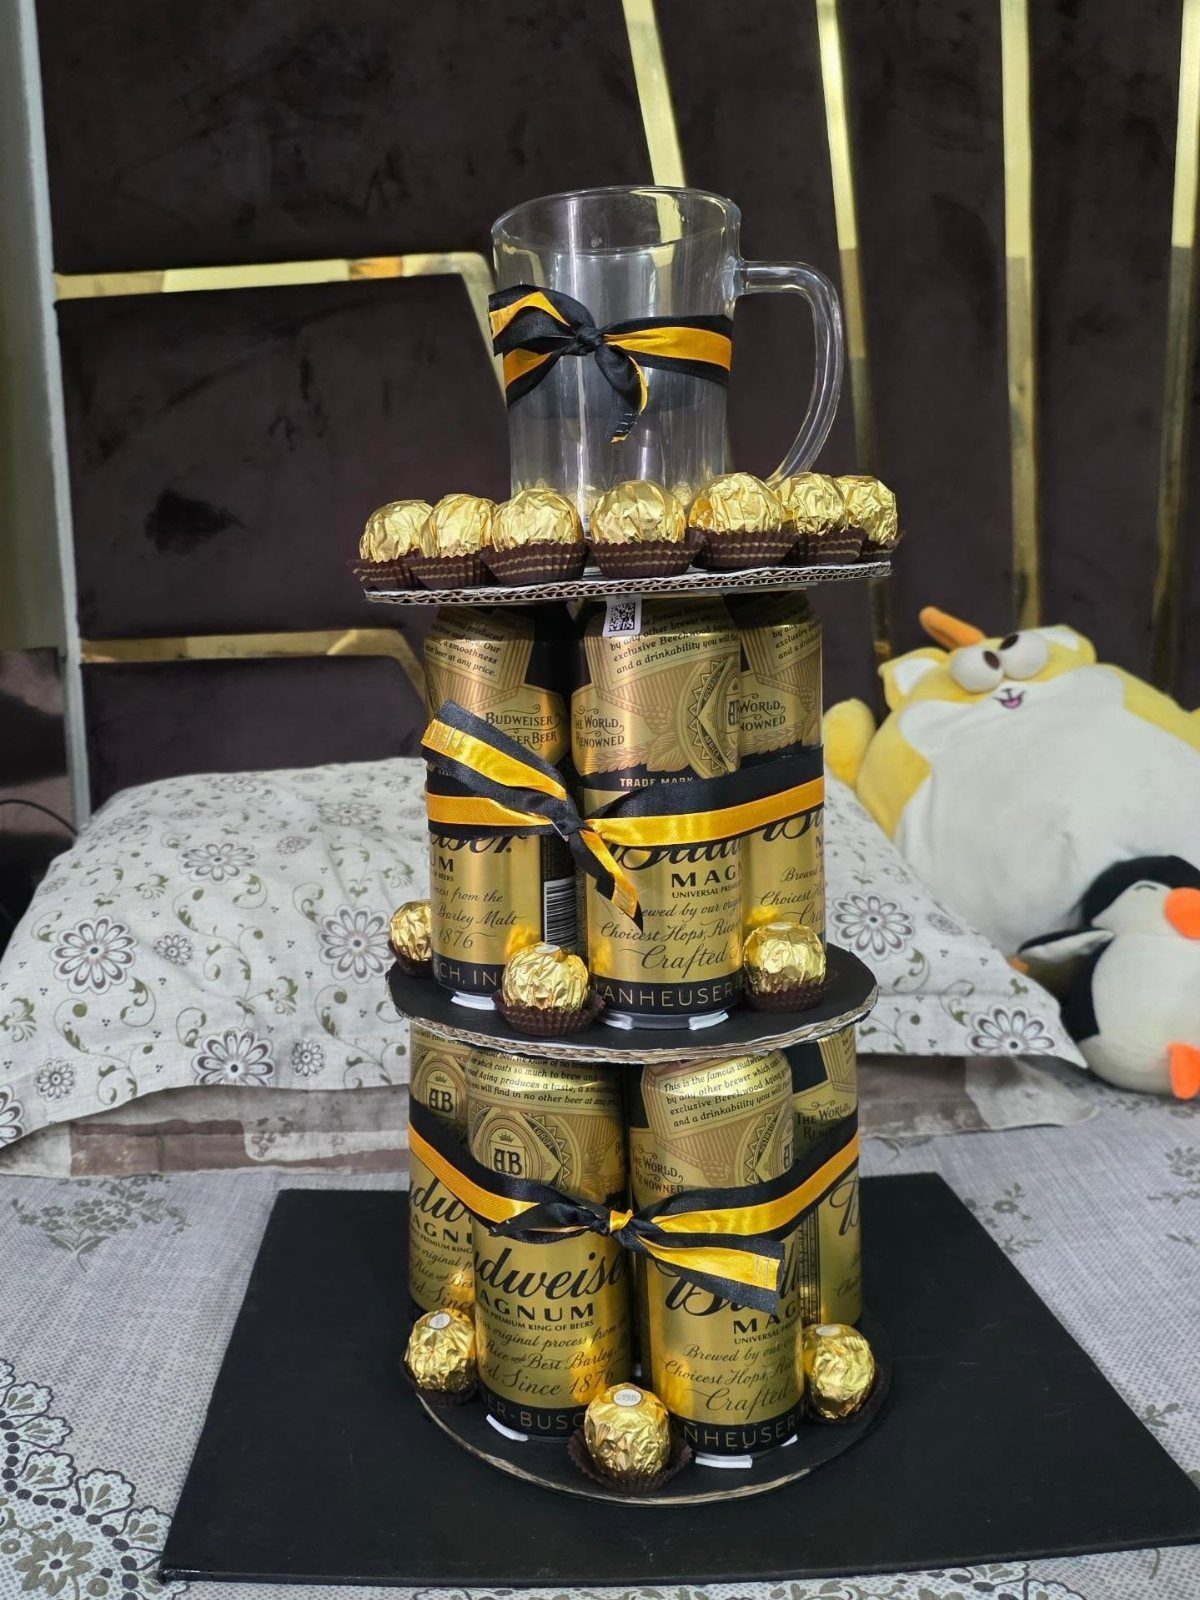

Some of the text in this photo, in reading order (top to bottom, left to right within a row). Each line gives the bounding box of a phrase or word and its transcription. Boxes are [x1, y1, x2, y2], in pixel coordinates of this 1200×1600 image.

[610, 641, 621, 652] by
[643, 624, 668, 638] other
[613, 640, 657, 662] exclusive
[659, 625, 711, 645] Beechwood
[771, 629, 783, 639] by
[449, 642, 498, 665] smoothness
[483, 642, 501, 654] Our
[616, 662, 634, 675] and
[644, 641, 701, 664] drinkability
[702, 638, 717, 649] you
[778, 646, 793, 660] and
[448, 653, 456, 662] at
[456, 657, 472, 669] any
[473, 663, 496, 677] price.
[485, 711, 553, 727] BUDWEISER
[532, 731, 558, 744] BEER
[576, 735, 625, 749] RENOWNED
[450, 886, 480, 904] from
[483, 889, 504, 903] the
[671, 887, 719, 899] UNIVERSAL
[758, 889, 811, 906] Choicest
[436, 901, 526, 929] Barley Malt
[679, 902, 698, 923] by
[700, 902, 721, 914] our
[439, 927, 494, 949] 1876
[600, 921, 661, 941] Choicest
[660, 923, 706, 945] Hops,
[624, 940, 728, 979] Crafted
[473, 969, 497, 986] IN
[602, 982, 735, 1007] ANHEUSER
[493, 1062, 512, 1073] costs
[525, 1068, 547, 1078] much
[550, 1071, 559, 1079] to
[560, 1072, 581, 1080] brew
[550, 1060, 559, 1069] of
[478, 1071, 498, 1083] Aging
[500, 1077, 541, 1090] produces
[664, 1082, 681, 1092] This
[683, 1079, 690, 1087] is
[692, 1076, 706, 1085] the
[706, 1066, 735, 1082] famous
[665, 1095, 677, 1105] by
[698, 1083, 722, 1096] other
[724, 1072, 751, 1088] brewer
[752, 1064, 771, 1077] which
[480, 1084, 492, 1094] will
[493, 1086, 510, 1097] find
[537, 1094, 563, 1103] other
[564, 1095, 584, 1104] beer
[584, 1097, 593, 1105] at
[670, 1099, 712, 1116] exclusive
[714, 1080, 763, 1104] Beechwood
[673, 1116, 691, 1128] and
[692, 1115, 698, 1123] a
[700, 1098, 754, 1120] drinkability
[756, 1092, 770, 1104] you
[795, 1112, 817, 1126] THE
[421, 1248, 462, 1267] original
[479, 1288, 595, 1322] AGNUM
[489, 1312, 594, 1332] PREMIUM KING OF BEERS
[492, 1327, 539, 1348] original
[541, 1336, 588, 1352] process
[734, 1328, 780, 1345] UNIVERSAL
[486, 1338, 509, 1362] Rice
[524, 1352, 561, 1371] Best
[684, 1343, 739, 1363] Brewed
[744, 1346, 760, 1367] by
[501, 1368, 562, 1396] Since
[665, 1360, 724, 1384] Choicest
[693, 1376, 789, 1420] Crafted
[684, 1415, 797, 1448] NHEUSER
